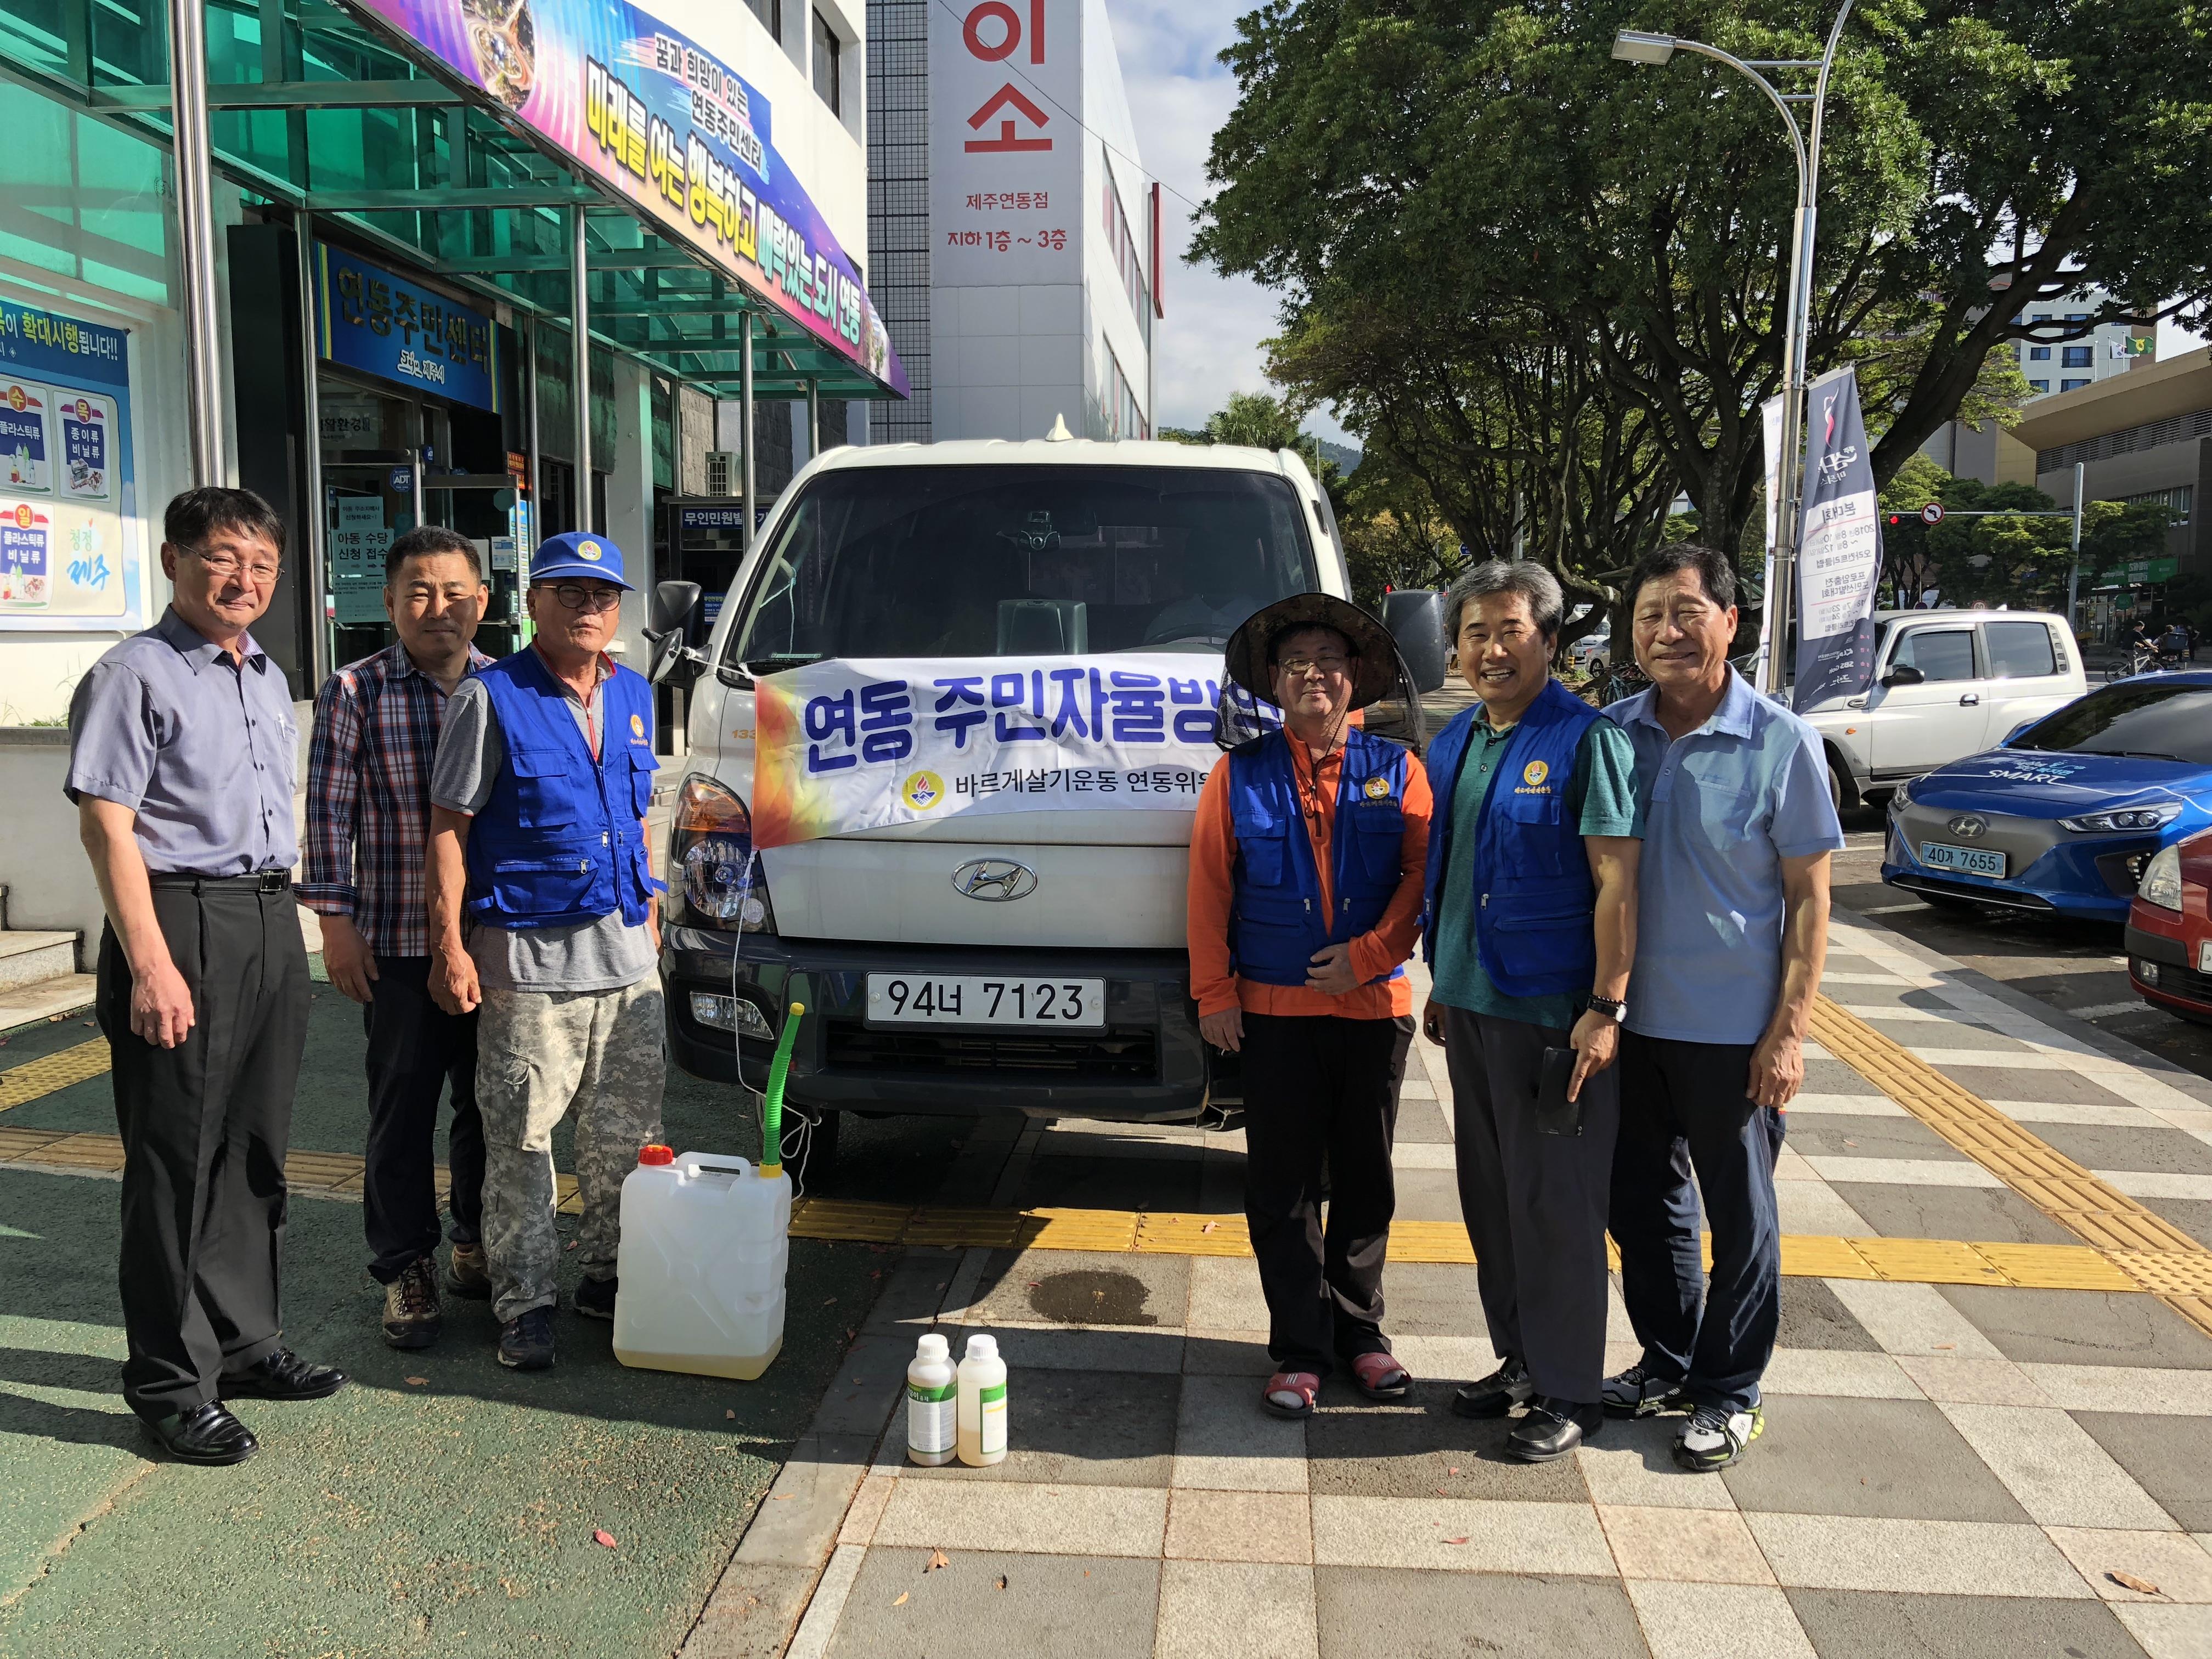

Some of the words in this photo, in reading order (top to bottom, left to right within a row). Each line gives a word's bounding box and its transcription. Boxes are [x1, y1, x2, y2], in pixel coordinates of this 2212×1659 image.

[655, 33, 683, 77] 꿈과
[686, 49, 723, 100] 희망이
[726, 77, 749, 117] 있는
[691, 89, 763, 173] 연동주민센터
[586, 55, 648, 181] 미래를
[649, 114, 685, 212] 여는
[687, 128, 758, 265] 행복하고
[758, 198, 815, 313] 매력있는
[814, 249, 838, 332] 도시
[839, 274, 861, 346] 연동
[966, 191, 1048, 211] 제주연동점
[337, 267, 488, 375] 연동주민센터
[21, 311, 118, 361] 확대시행됩니다!!
[423, 360, 445, 385] 제주시
[12, 389, 24, 408] 수
[0, 421, 40, 441] 플라스틱류
[393, 475, 410, 484] ADT
[18, 507, 30, 527] 일
[3, 531, 44, 548] 플라스틱류
[70, 529, 92, 552] 청정
[338, 533, 360, 545] 아동
[365, 533, 388, 544] 수당
[8, 549, 41, 565] 비닐류
[339, 548, 360, 560] 신청
[366, 548, 388, 560] 접수
[66, 554, 110, 591] 제주
[805, 680, 913, 774] 연동
[956, 768, 1119, 798] 바르게살기운동
[1989, 770, 2066, 784] SMART
[1928, 848, 1954, 864] 40가
[1961, 852, 1996, 871] 7655
[888, 980, 961, 1017] 94너
[983, 983, 1083, 1020] 7123
